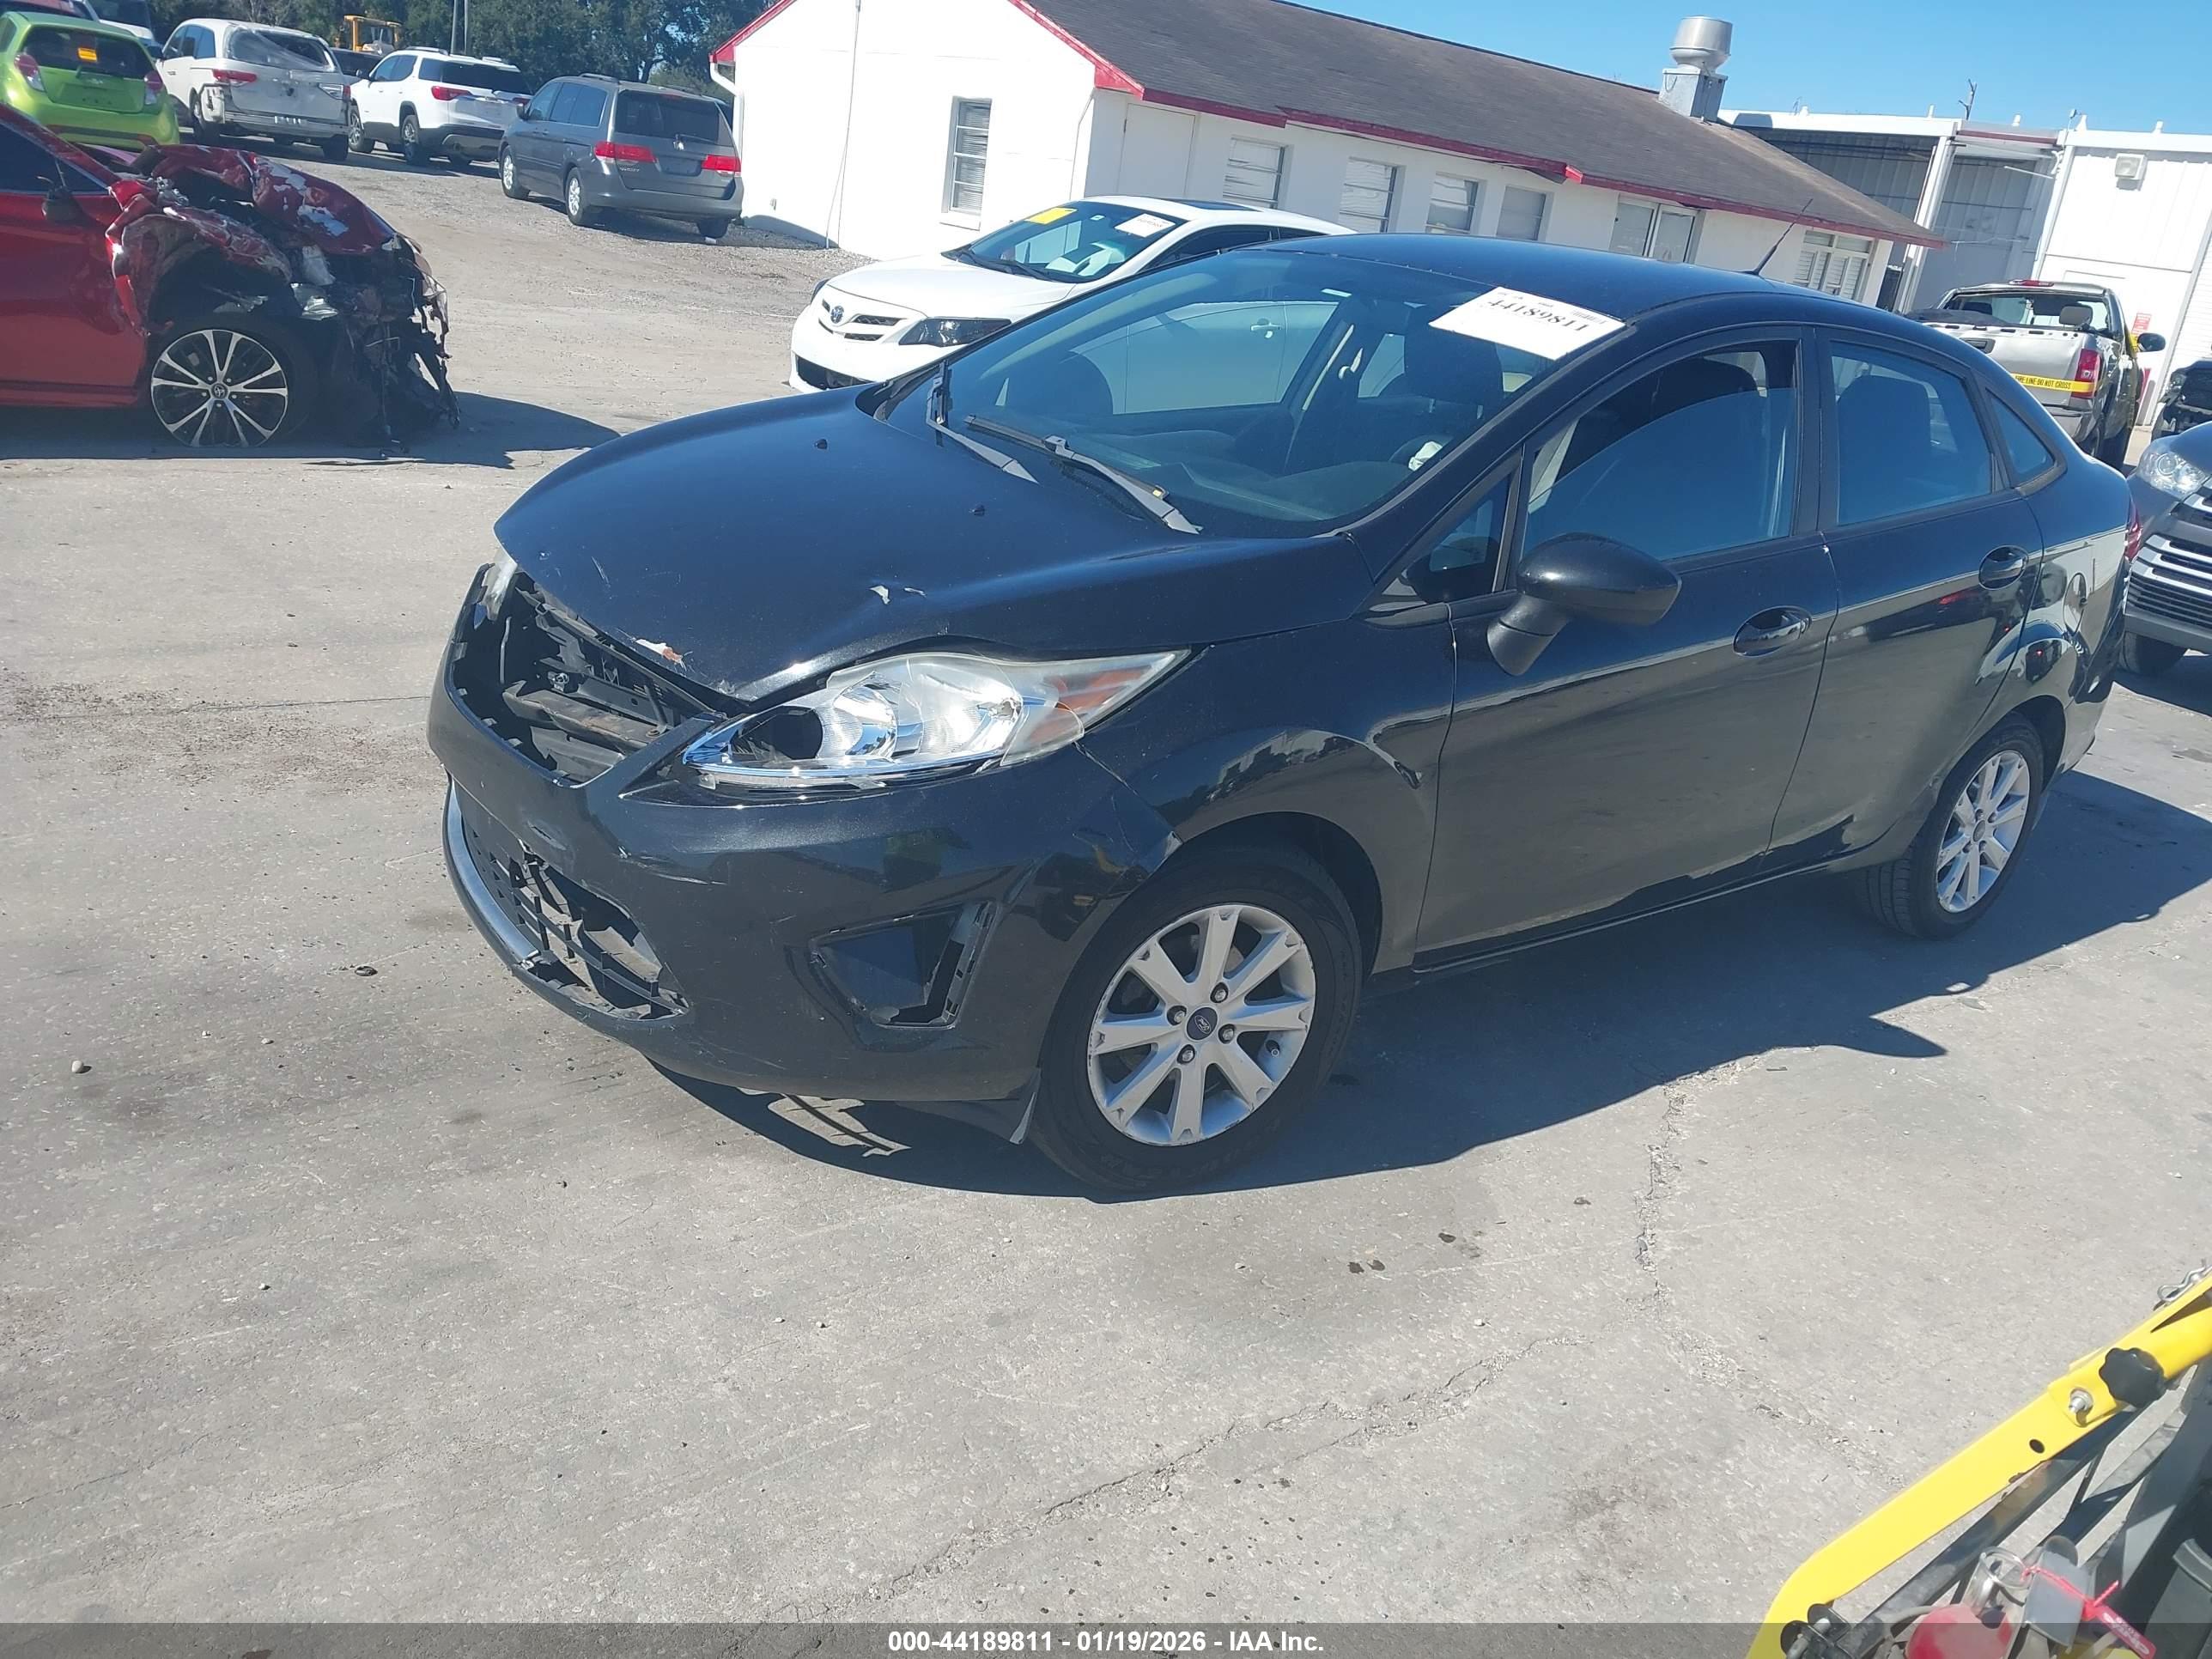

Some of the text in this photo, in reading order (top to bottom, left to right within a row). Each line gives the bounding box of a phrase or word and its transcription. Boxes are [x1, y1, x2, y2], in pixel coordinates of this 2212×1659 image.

[1487, 299, 1590, 331] 44189811
[2045, 379, 2054, 387] NOT
[2055, 380, 2071, 389] CROSS
